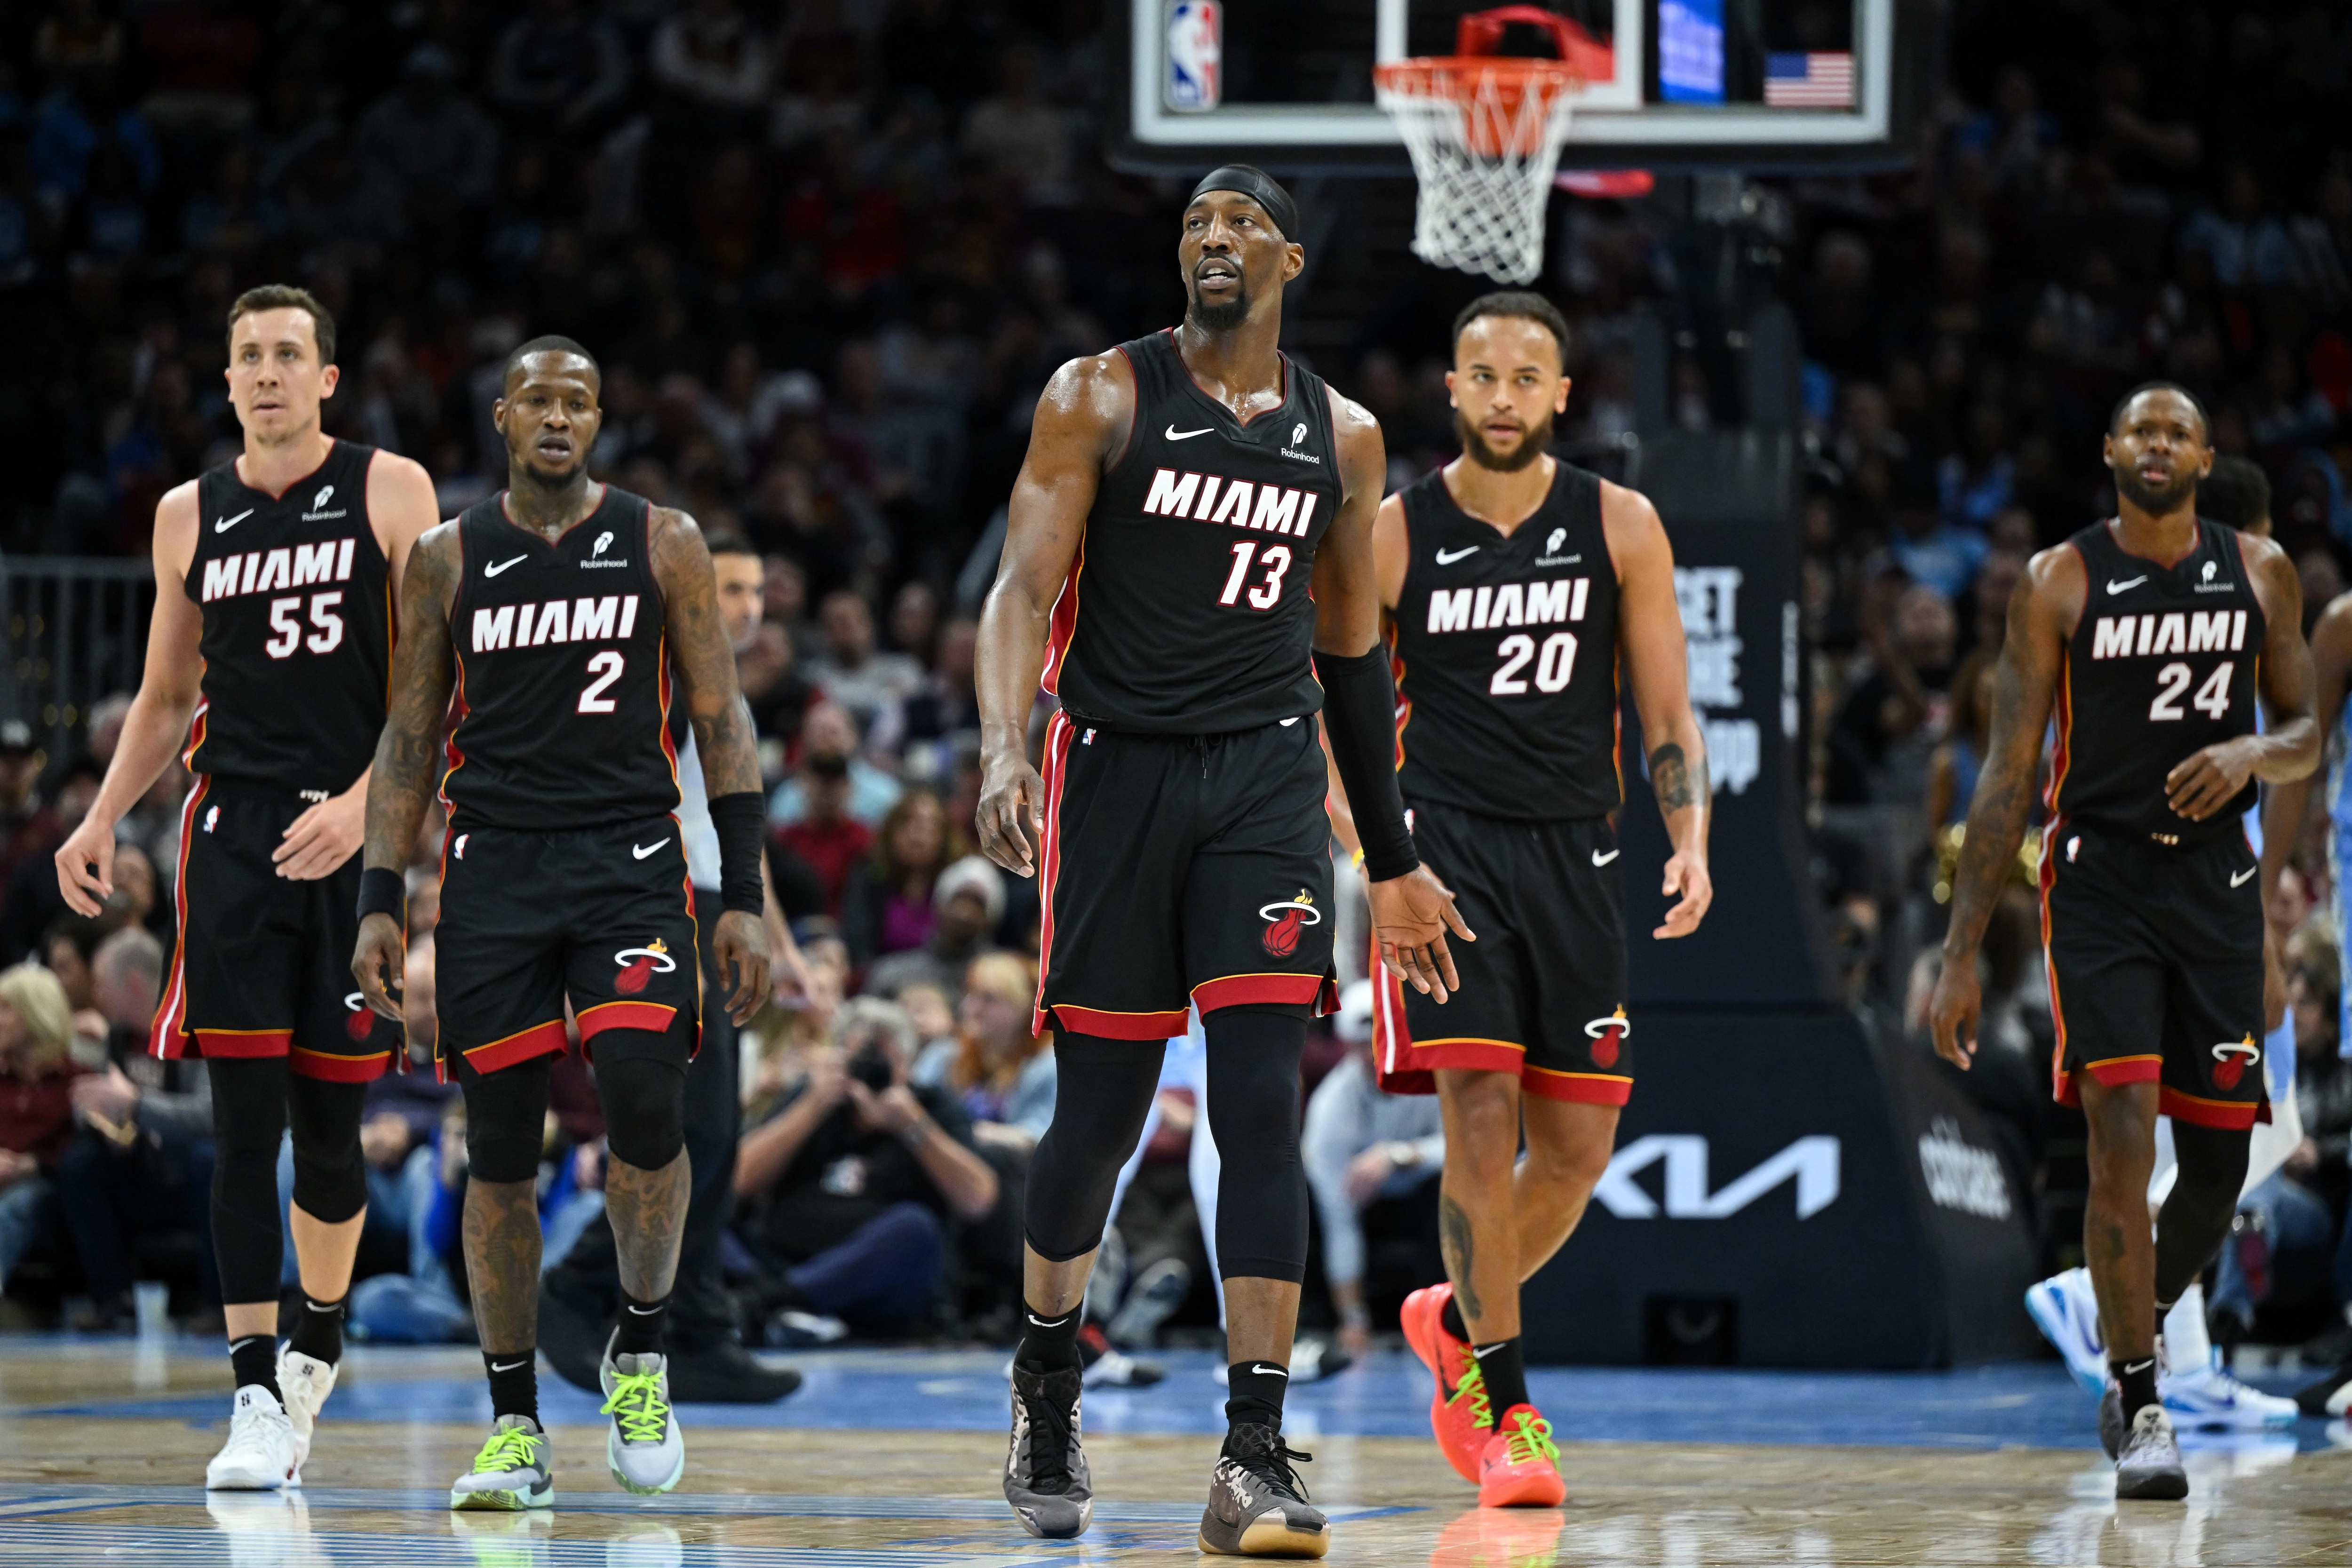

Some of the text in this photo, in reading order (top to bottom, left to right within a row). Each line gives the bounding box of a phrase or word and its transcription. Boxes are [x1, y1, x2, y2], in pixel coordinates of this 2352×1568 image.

[1281, 447, 1319, 464] Robinhood
[302, 508, 347, 522] Robinhood
[1142, 466, 1319, 539] MIAMI
[201, 537, 357, 604] MIAMI
[580, 558, 628, 569] Robinhood
[1216, 539, 1294, 612] 13
[264, 590, 345, 661] 55
[471, 594, 640, 654] MIAMI
[1426, 577, 1590, 634] MIAMI
[2091, 609, 2248, 660] MIAMI
[575, 649, 627, 715] 2
[1489, 631, 1579, 696] 20
[2148, 661, 2235, 722] 24
